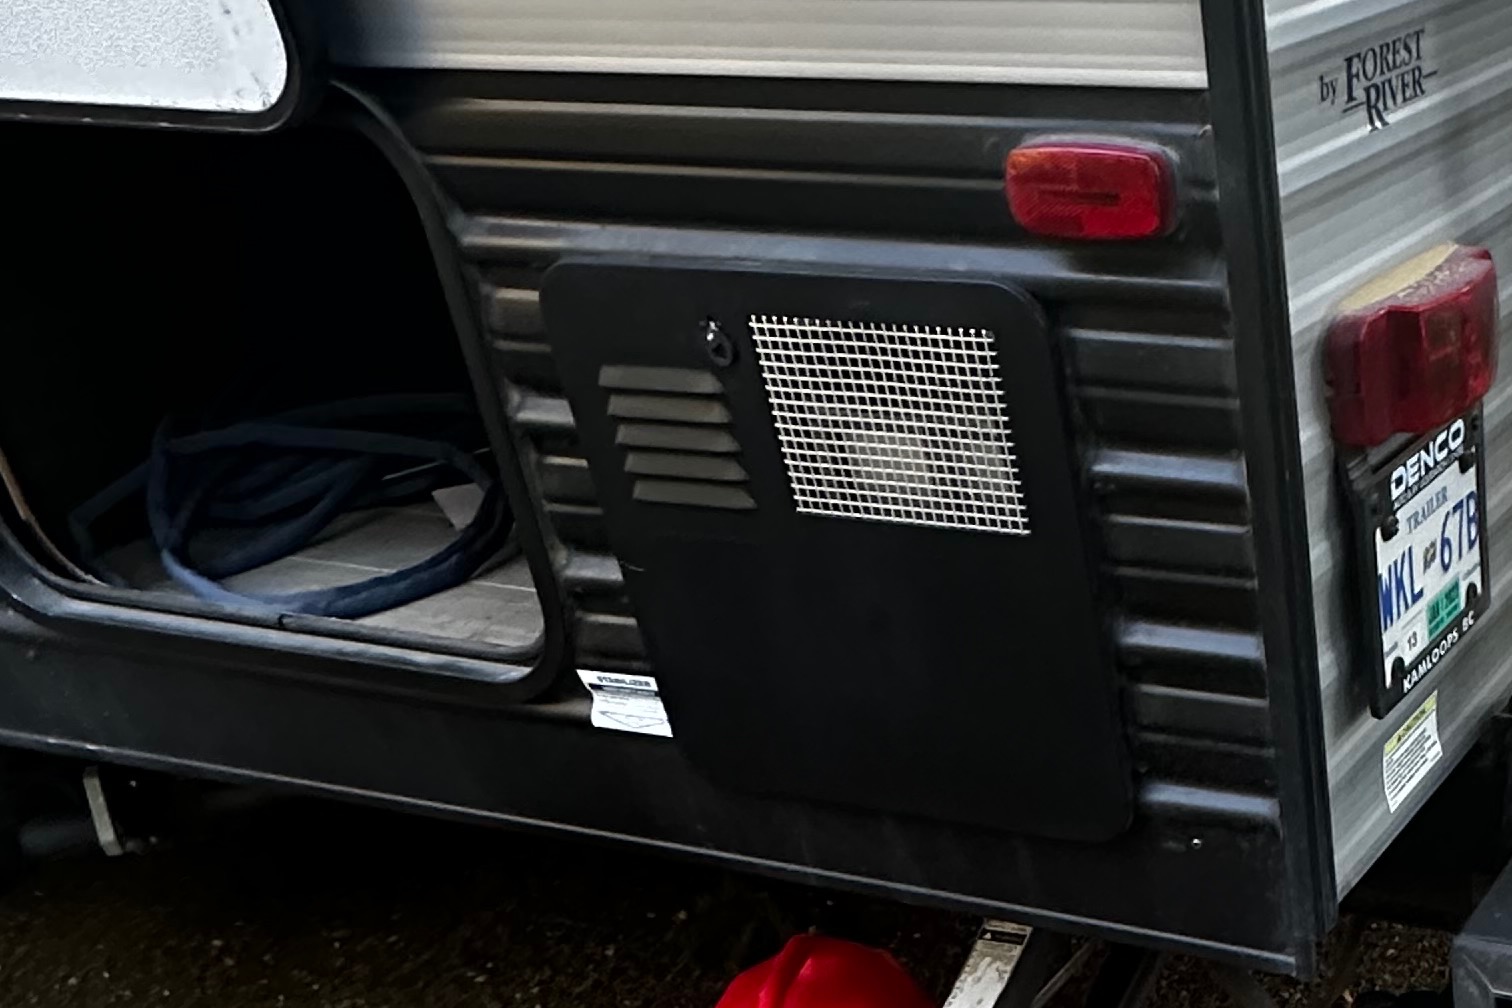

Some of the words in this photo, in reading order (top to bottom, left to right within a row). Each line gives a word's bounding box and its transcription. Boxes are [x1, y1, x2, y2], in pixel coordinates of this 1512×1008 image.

[1318, 75, 1337, 105] by
[1344, 28, 1425, 104] FOREST
[1363, 64, 1426, 133] RIVER
[1390, 418, 1465, 502] DENCO
[1406, 485, 1448, 534] TRAILER
[1376, 543, 1425, 633] WKL
[1440, 490, 1480, 574] 67B
[1402, 627, 1459, 694] KAMLOOPS
[1461, 609, 1475, 633] BC
